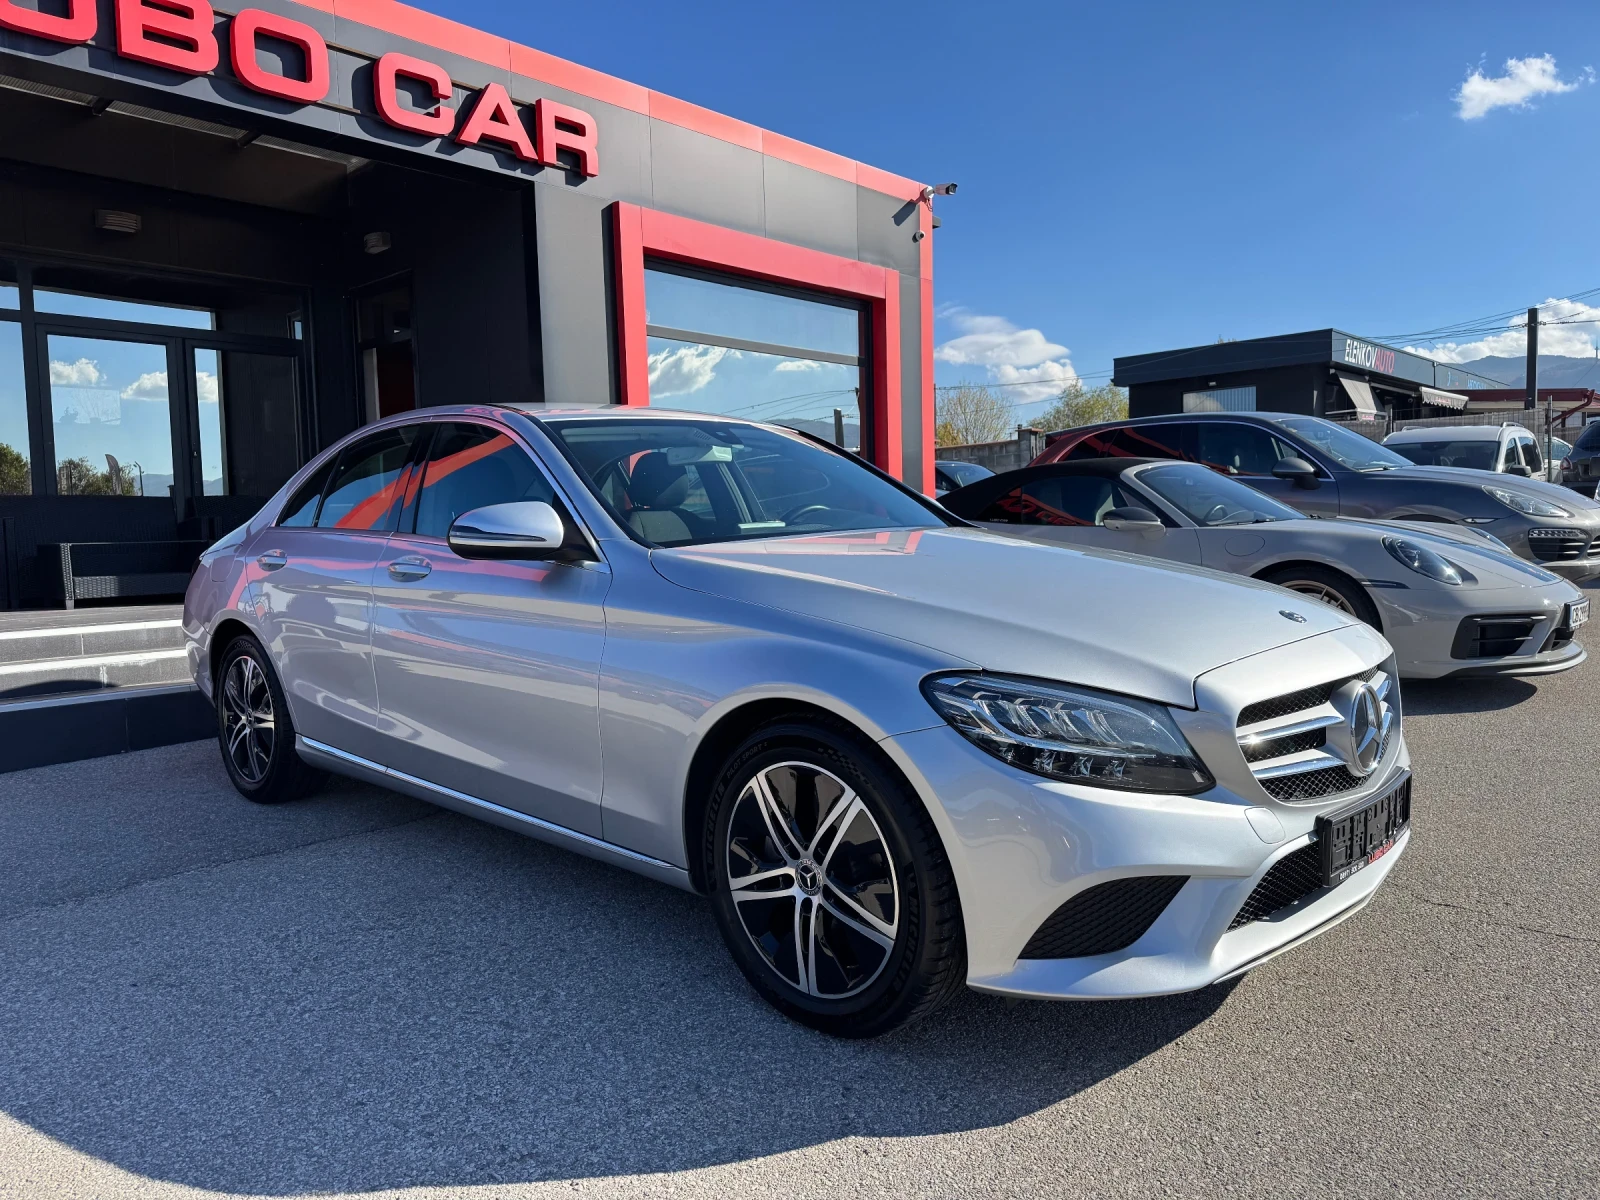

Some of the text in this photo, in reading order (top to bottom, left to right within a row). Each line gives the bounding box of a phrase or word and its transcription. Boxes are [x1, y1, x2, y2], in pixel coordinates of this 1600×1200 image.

[374, 52, 598, 177] CAR
[726, 758, 742, 779] PILOT
[742, 744, 763, 761] SPORT
